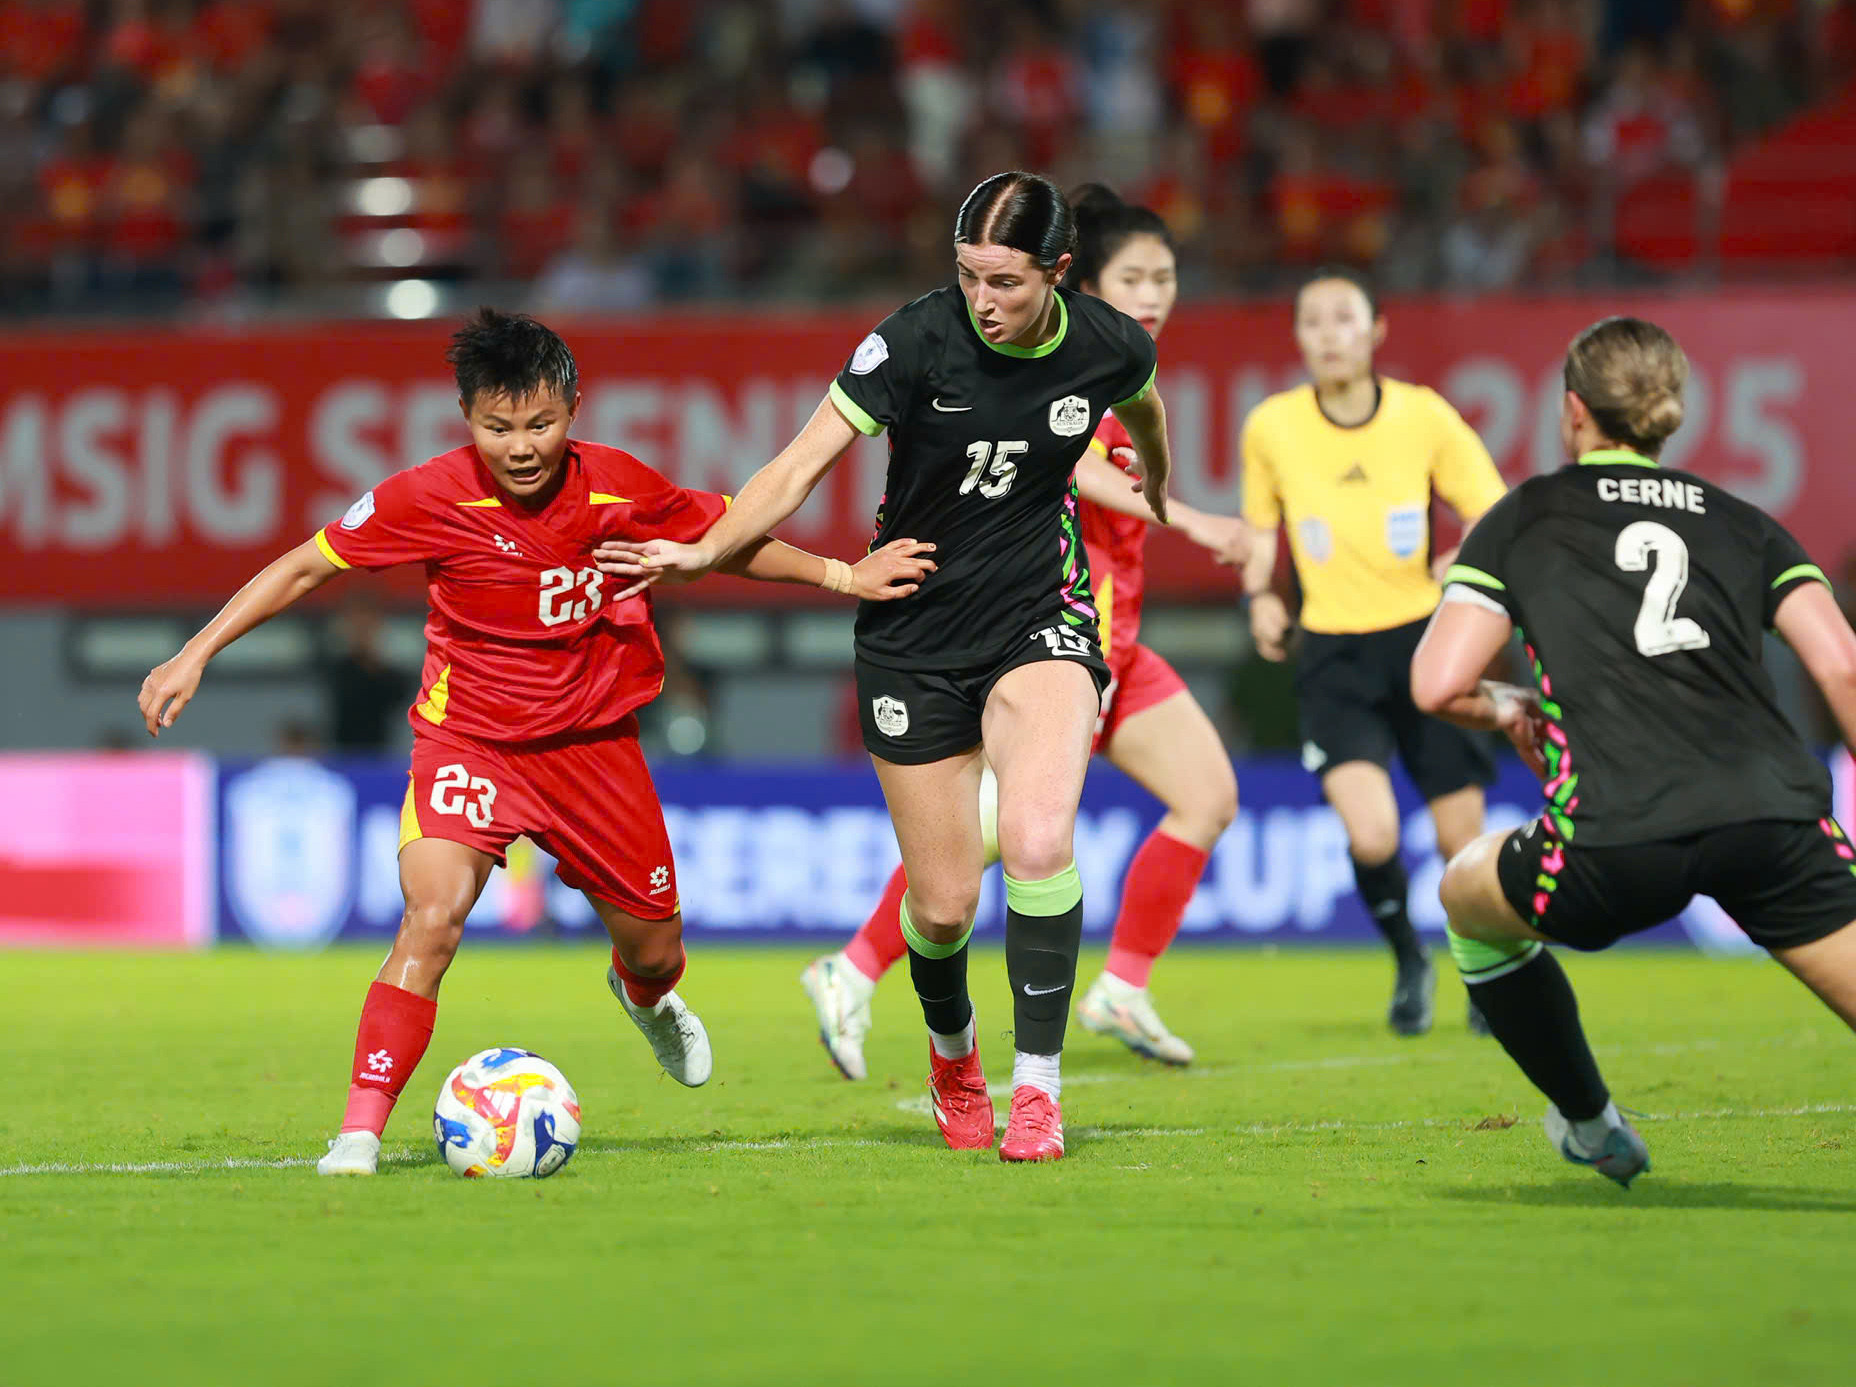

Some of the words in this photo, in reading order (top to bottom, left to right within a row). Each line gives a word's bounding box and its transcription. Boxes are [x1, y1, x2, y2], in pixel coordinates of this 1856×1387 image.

[959, 440, 1029, 499] 15
[1597, 478, 1706, 515] CERNE
[538, 565, 604, 627] 23
[1615, 520, 1711, 657] 2
[429, 764, 498, 828] 23
